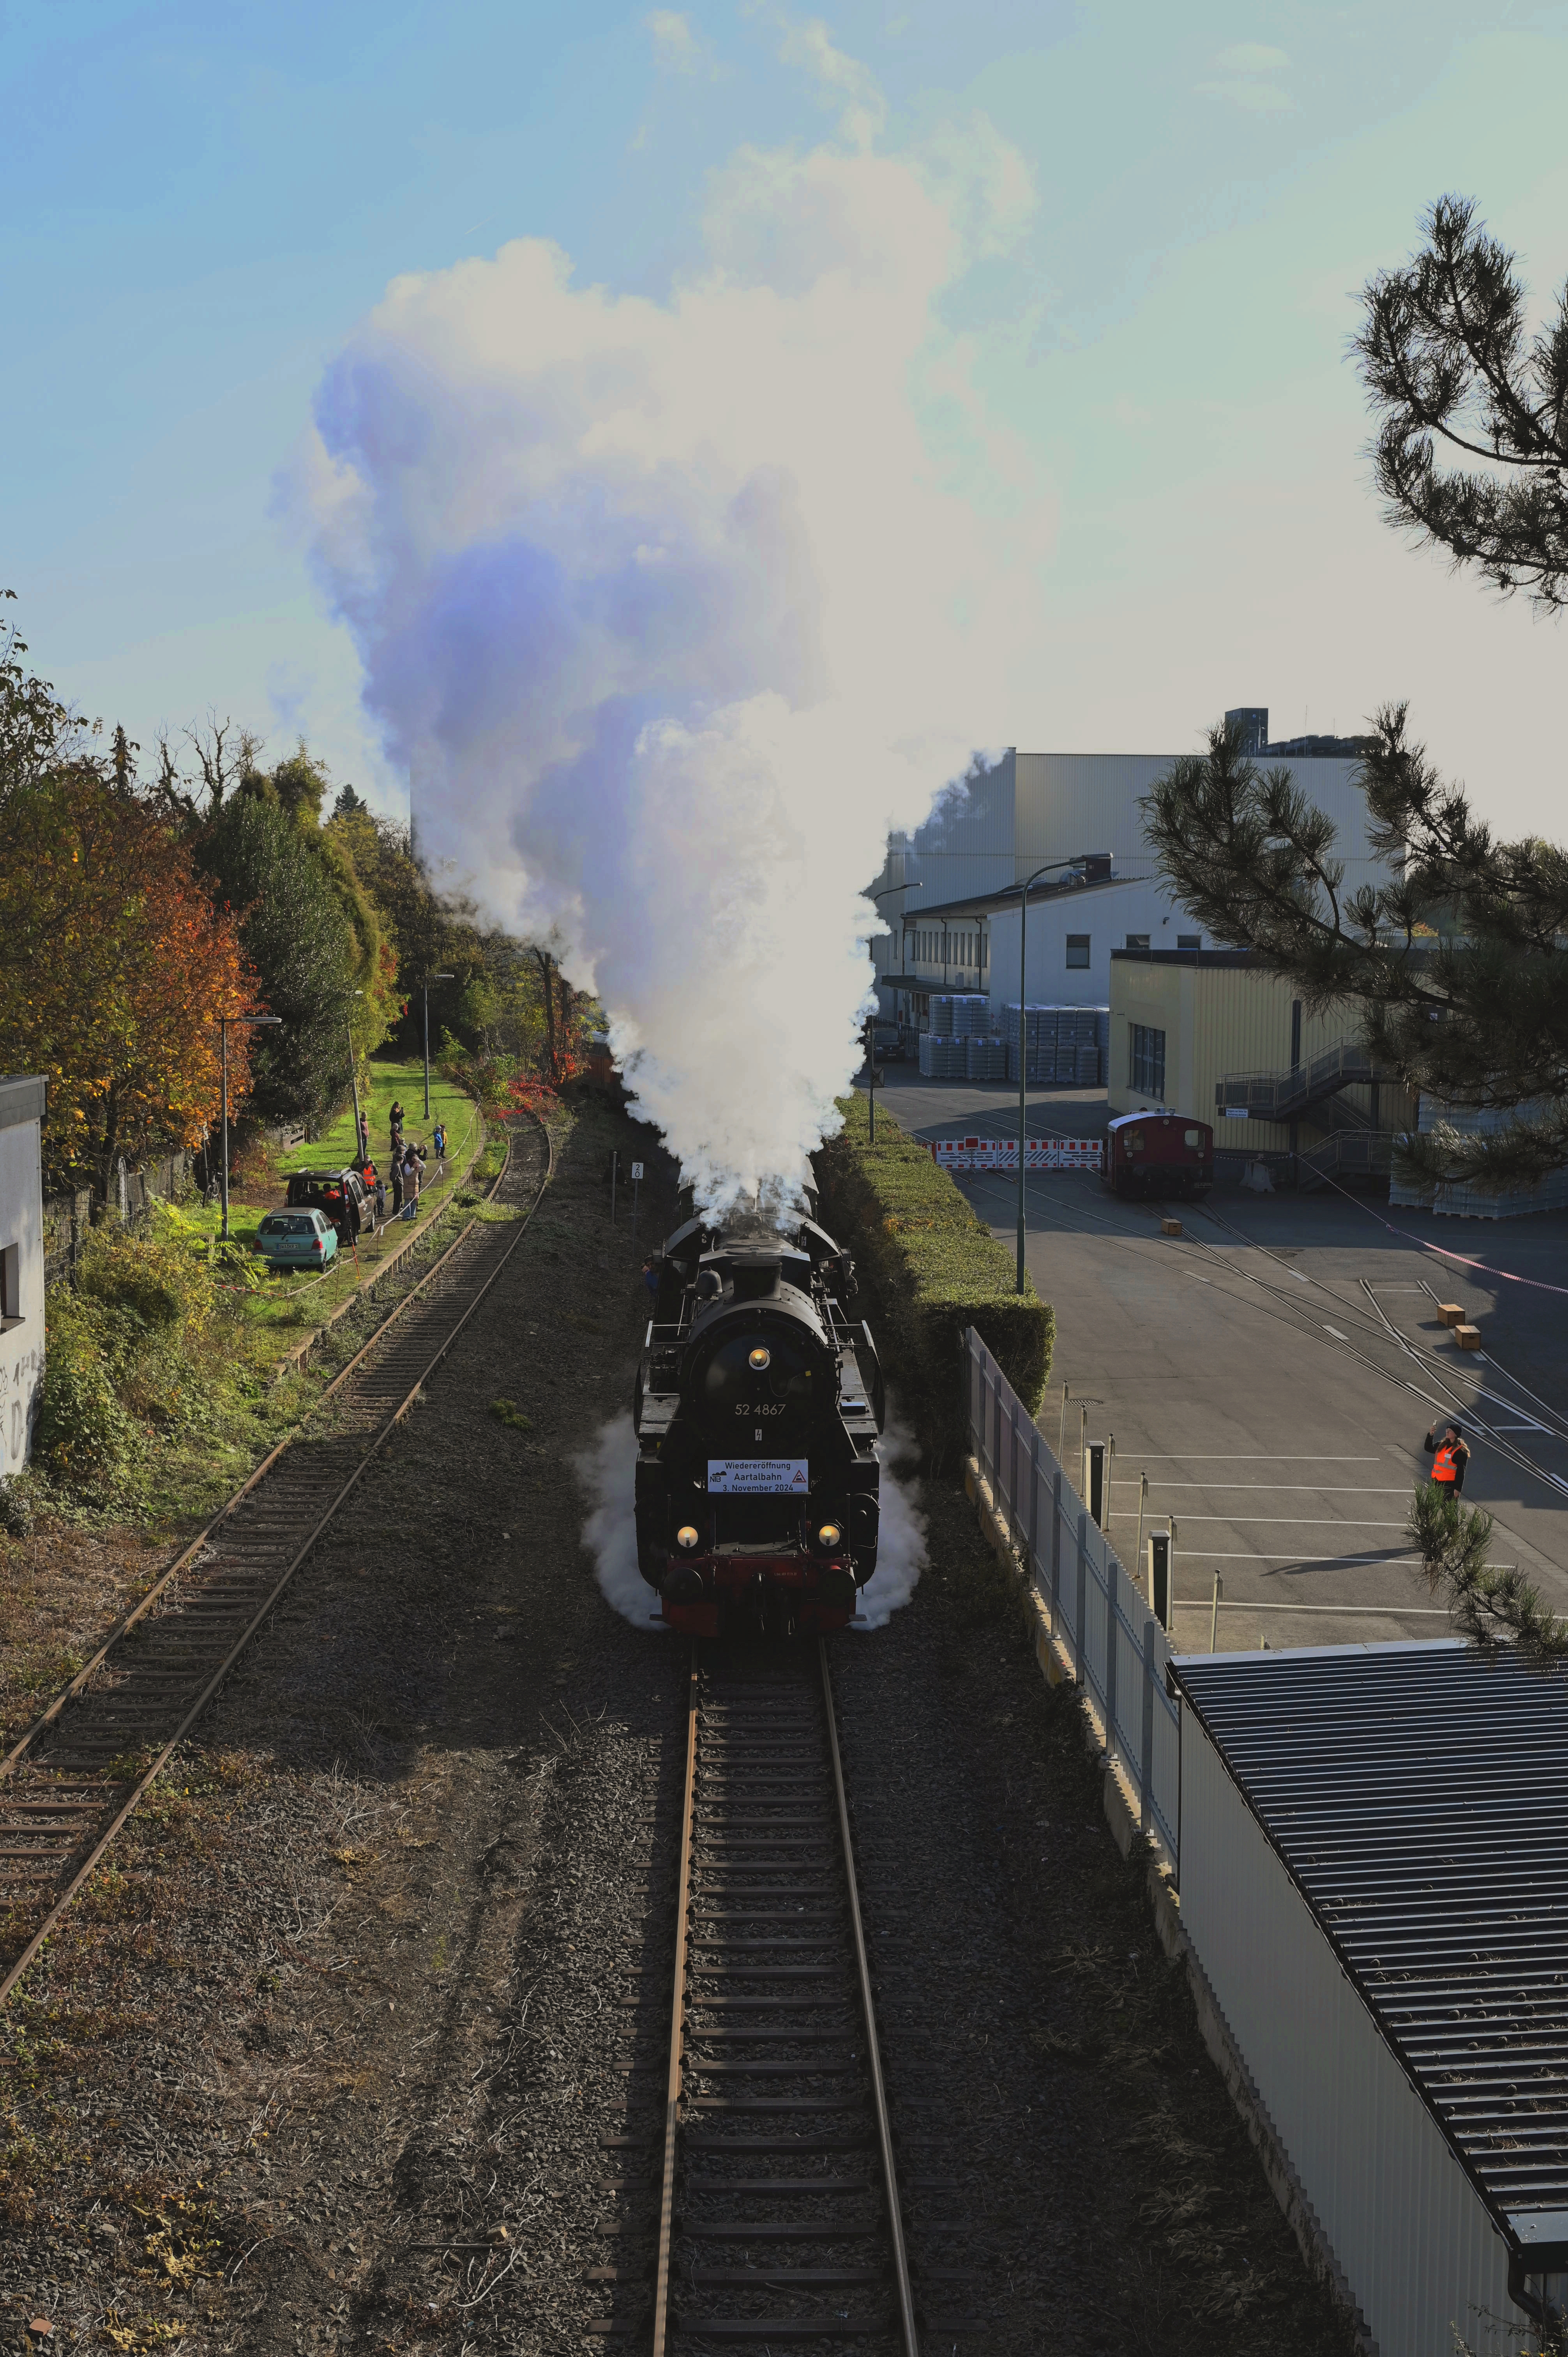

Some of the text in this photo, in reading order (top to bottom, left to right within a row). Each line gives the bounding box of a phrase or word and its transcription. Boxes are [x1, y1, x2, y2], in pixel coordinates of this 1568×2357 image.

[735, 1404, 786, 1415] 52 4867
[725, 1462, 791, 1470] Wiedereröffnung
